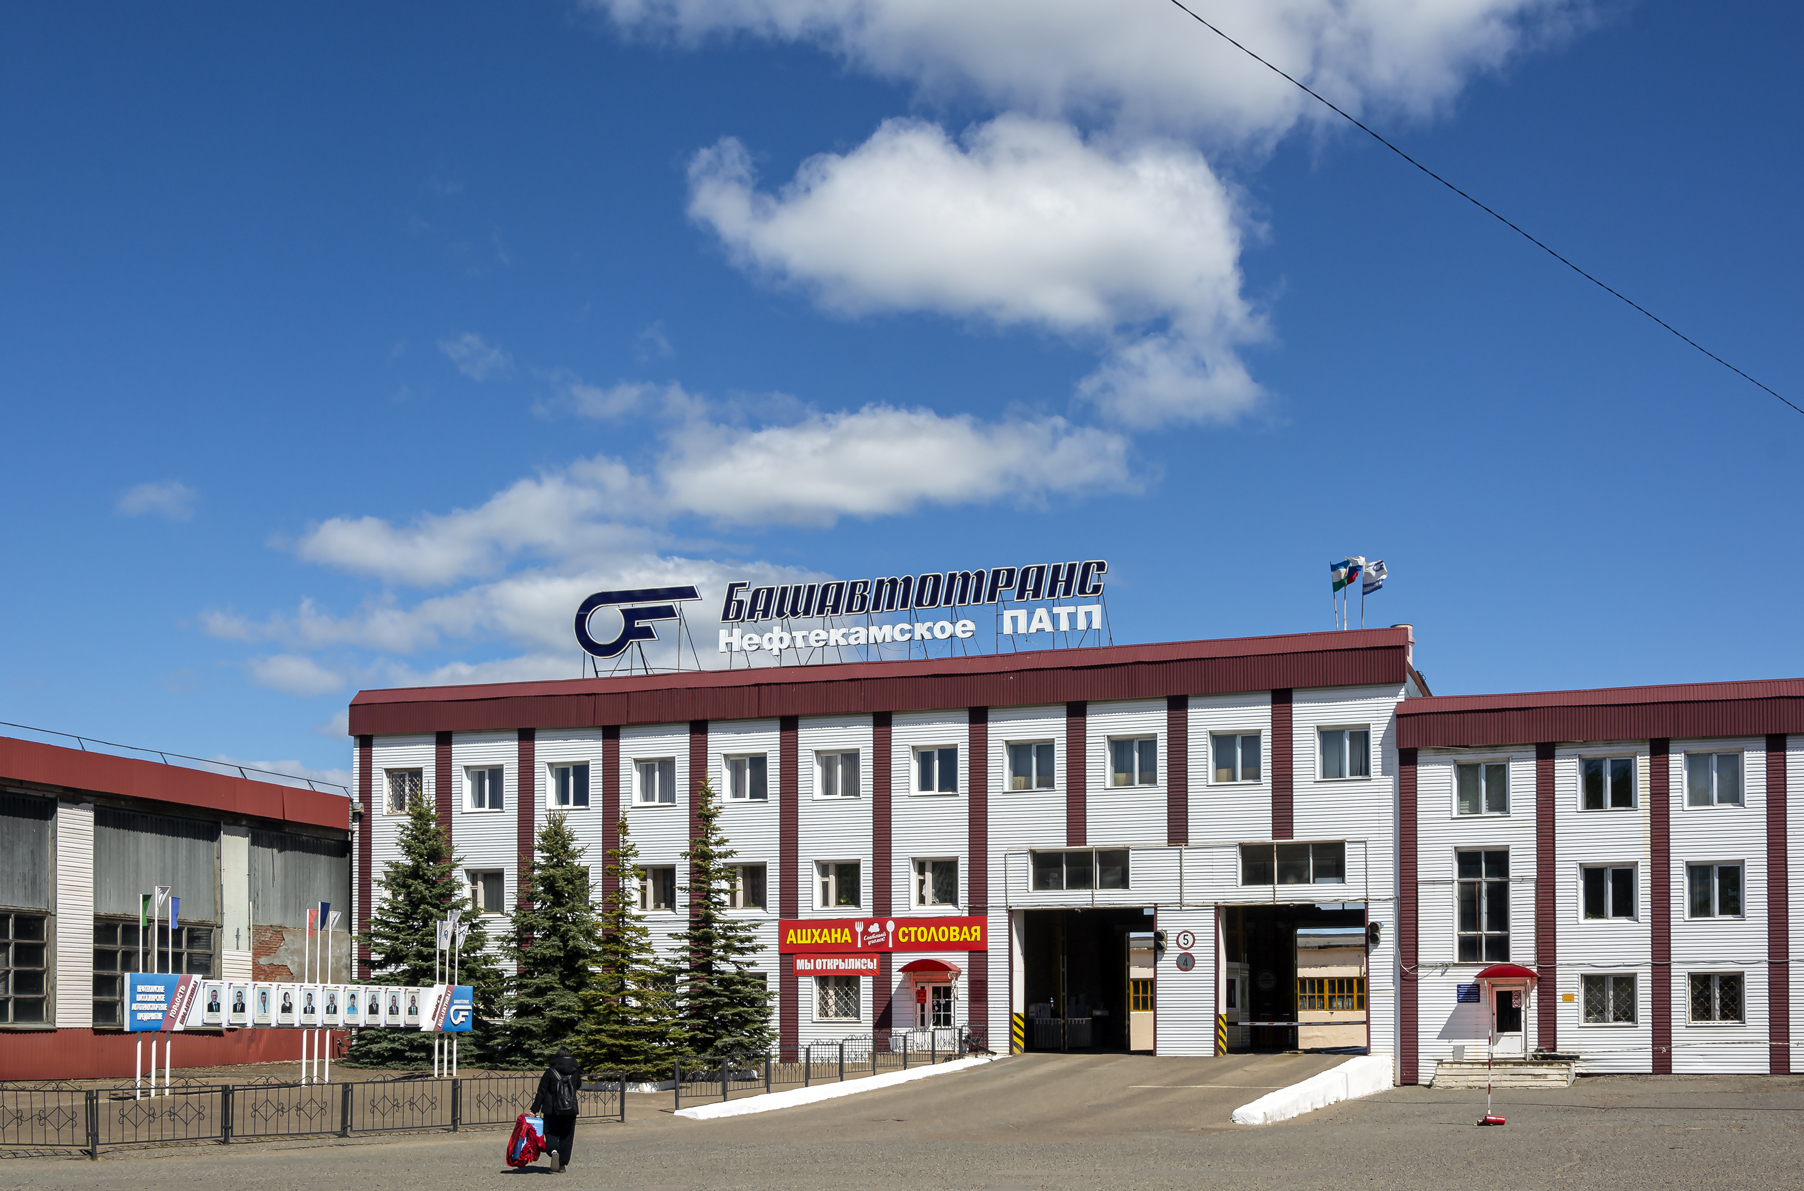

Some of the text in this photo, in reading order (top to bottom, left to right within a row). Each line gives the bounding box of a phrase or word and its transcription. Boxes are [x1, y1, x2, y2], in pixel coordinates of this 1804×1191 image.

[718, 604, 1102, 656] Нефтекамское ПАТП
[786, 927, 852, 944] АШХАНА
[898, 925, 981, 943] СТОЛОВАЯ
[1183, 934, 1189, 945] 5
[796, 958, 877, 970] МЫ ОТКРЫЛИСЬ!
[1182, 957, 1188, 967] 4
[169, 985, 186, 1019] ГОРДОСТЬ
